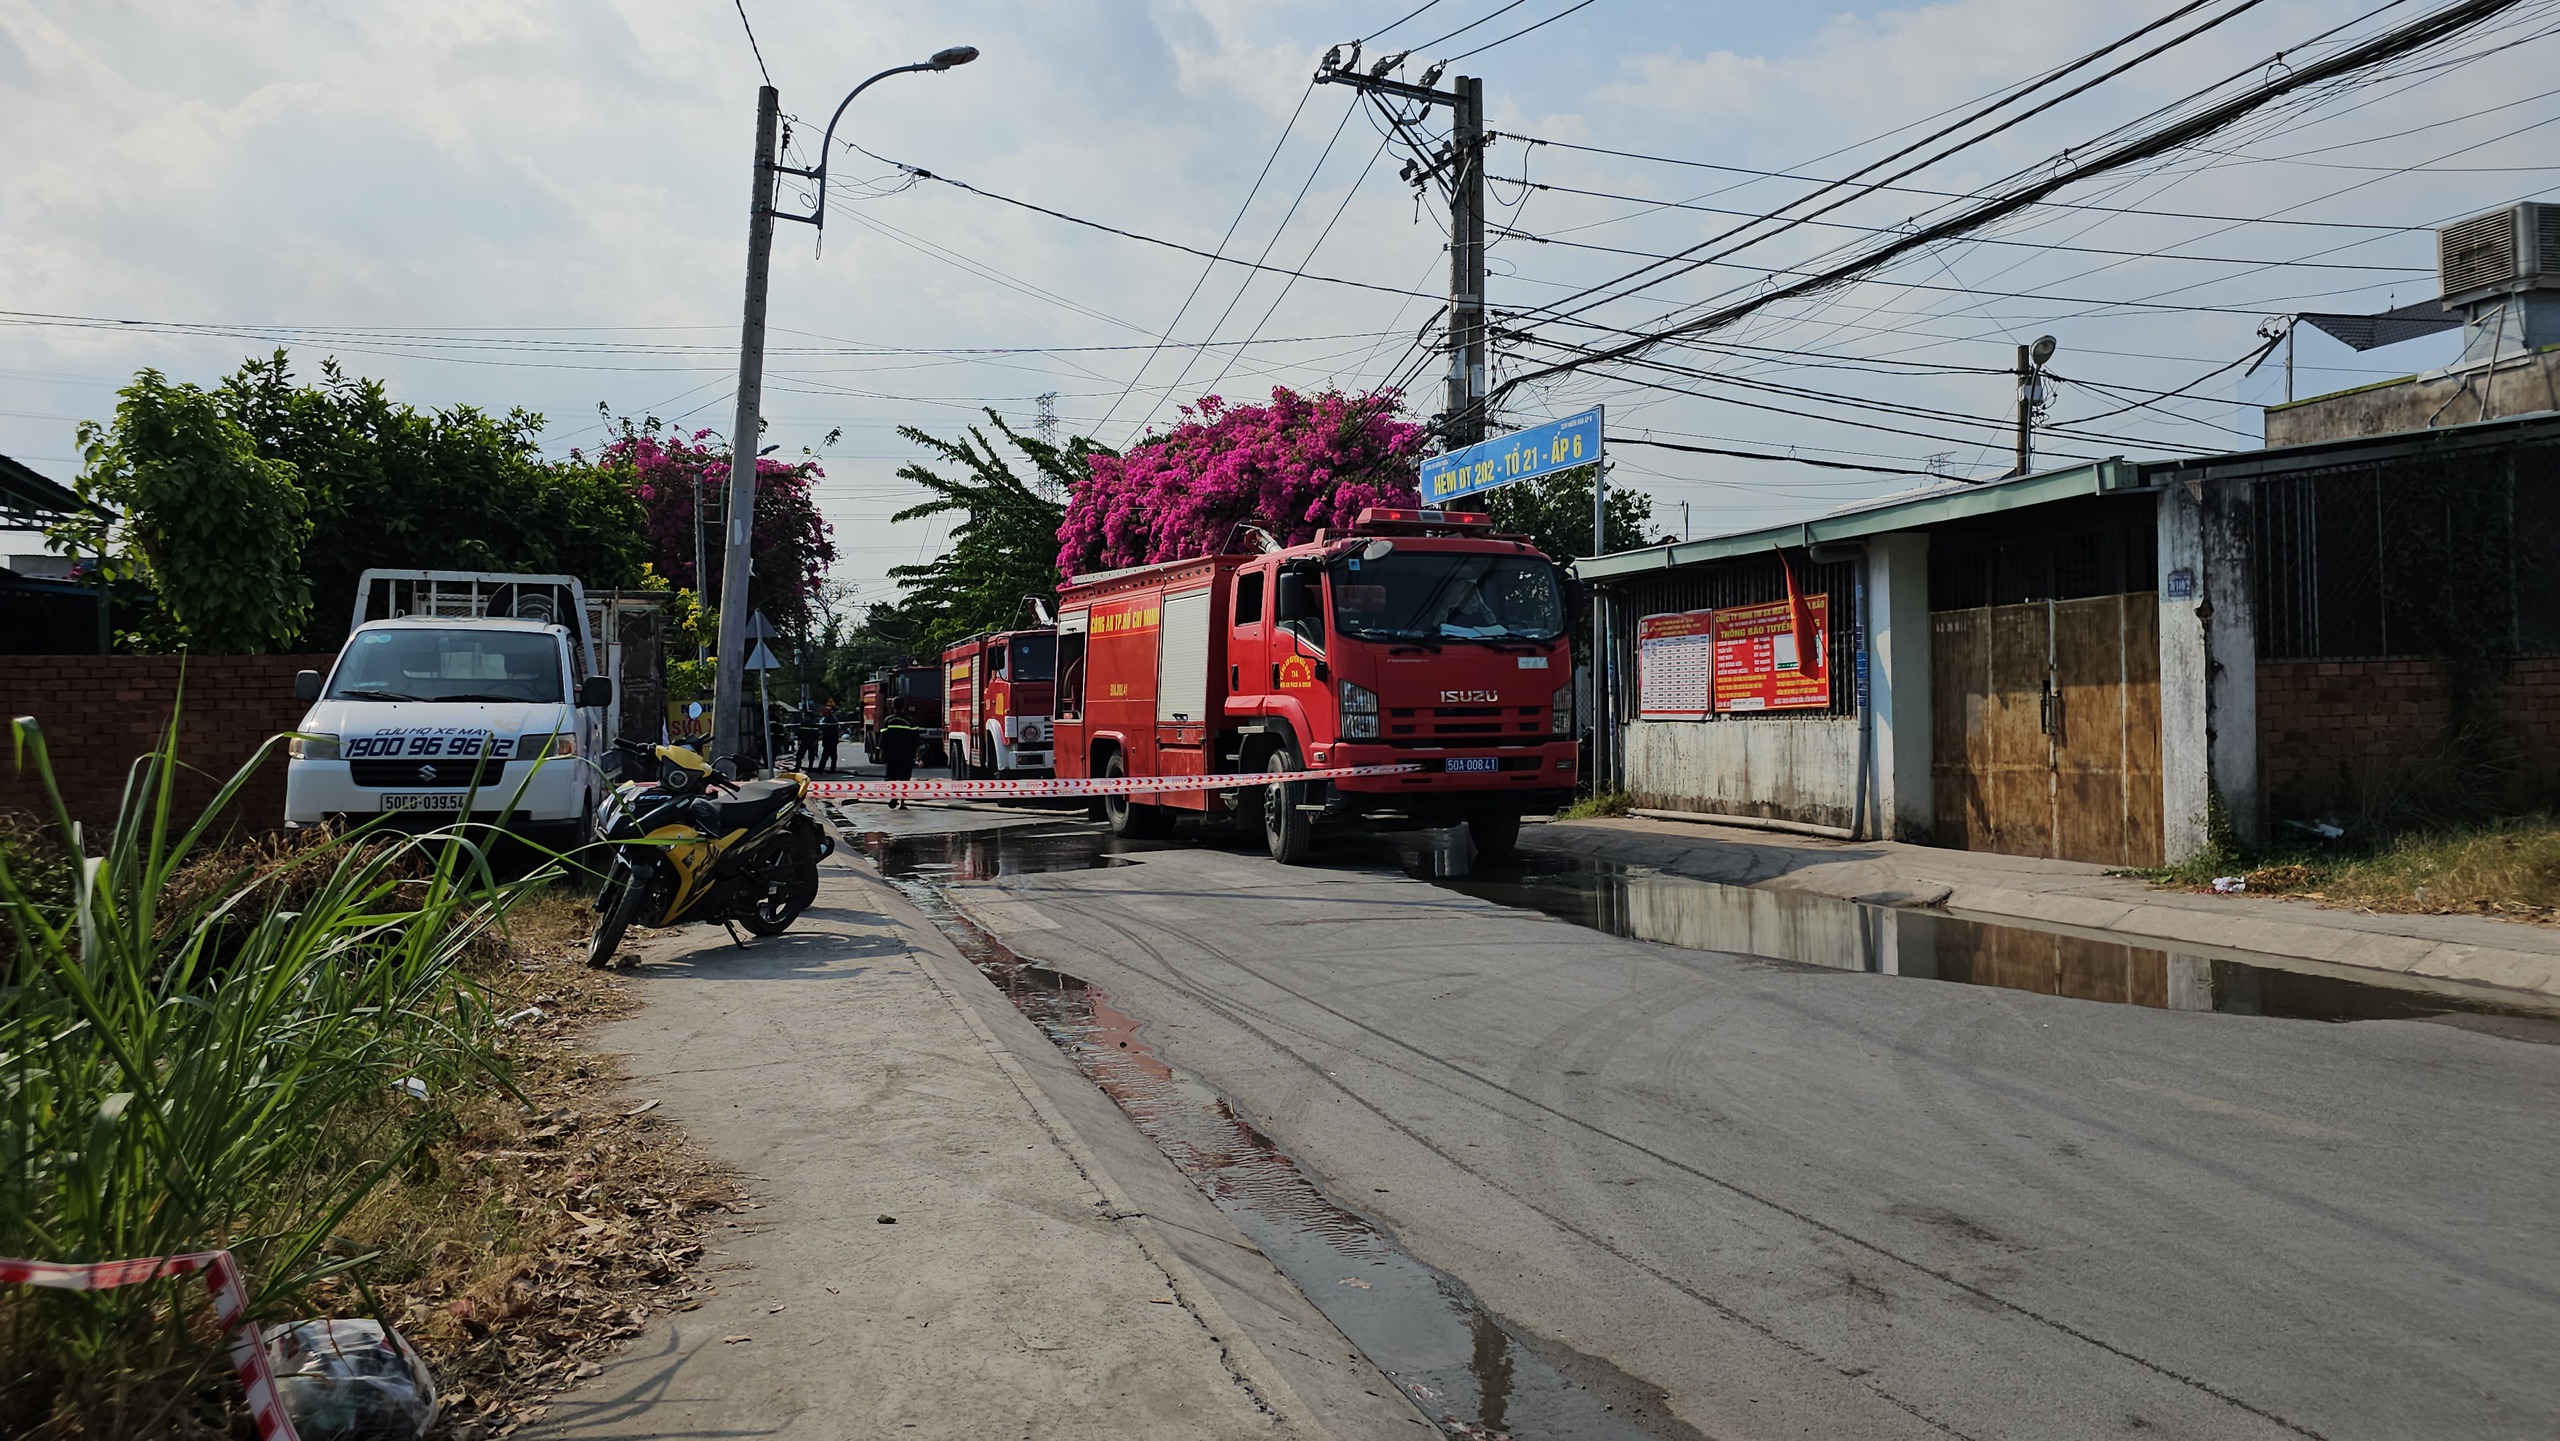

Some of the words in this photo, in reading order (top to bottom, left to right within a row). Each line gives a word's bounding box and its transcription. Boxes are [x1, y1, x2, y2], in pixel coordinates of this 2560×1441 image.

[1434, 466, 1457, 496] HẺM
[1459, 464, 1472, 490] ĐT
[1475, 459, 1495, 485] 202
[1504, 442, 1520, 476] TỔ
[1523, 446, 1538, 472] 21
[1552, 430, 1570, 464] ẤP
[1573, 434, 1582, 458] 6
[1090, 614, 1105, 634] CÔNG
[1106, 615, 1114, 632] AN
[1720, 628, 1746, 639] THÔNG
[1748, 626, 1764, 636] BÁO
[1766, 620, 1793, 633] TUYỂN
[1440, 690, 1498, 702] ISUZU
[345, 738, 406, 758] 1900
[408, 737, 444, 756] 96
